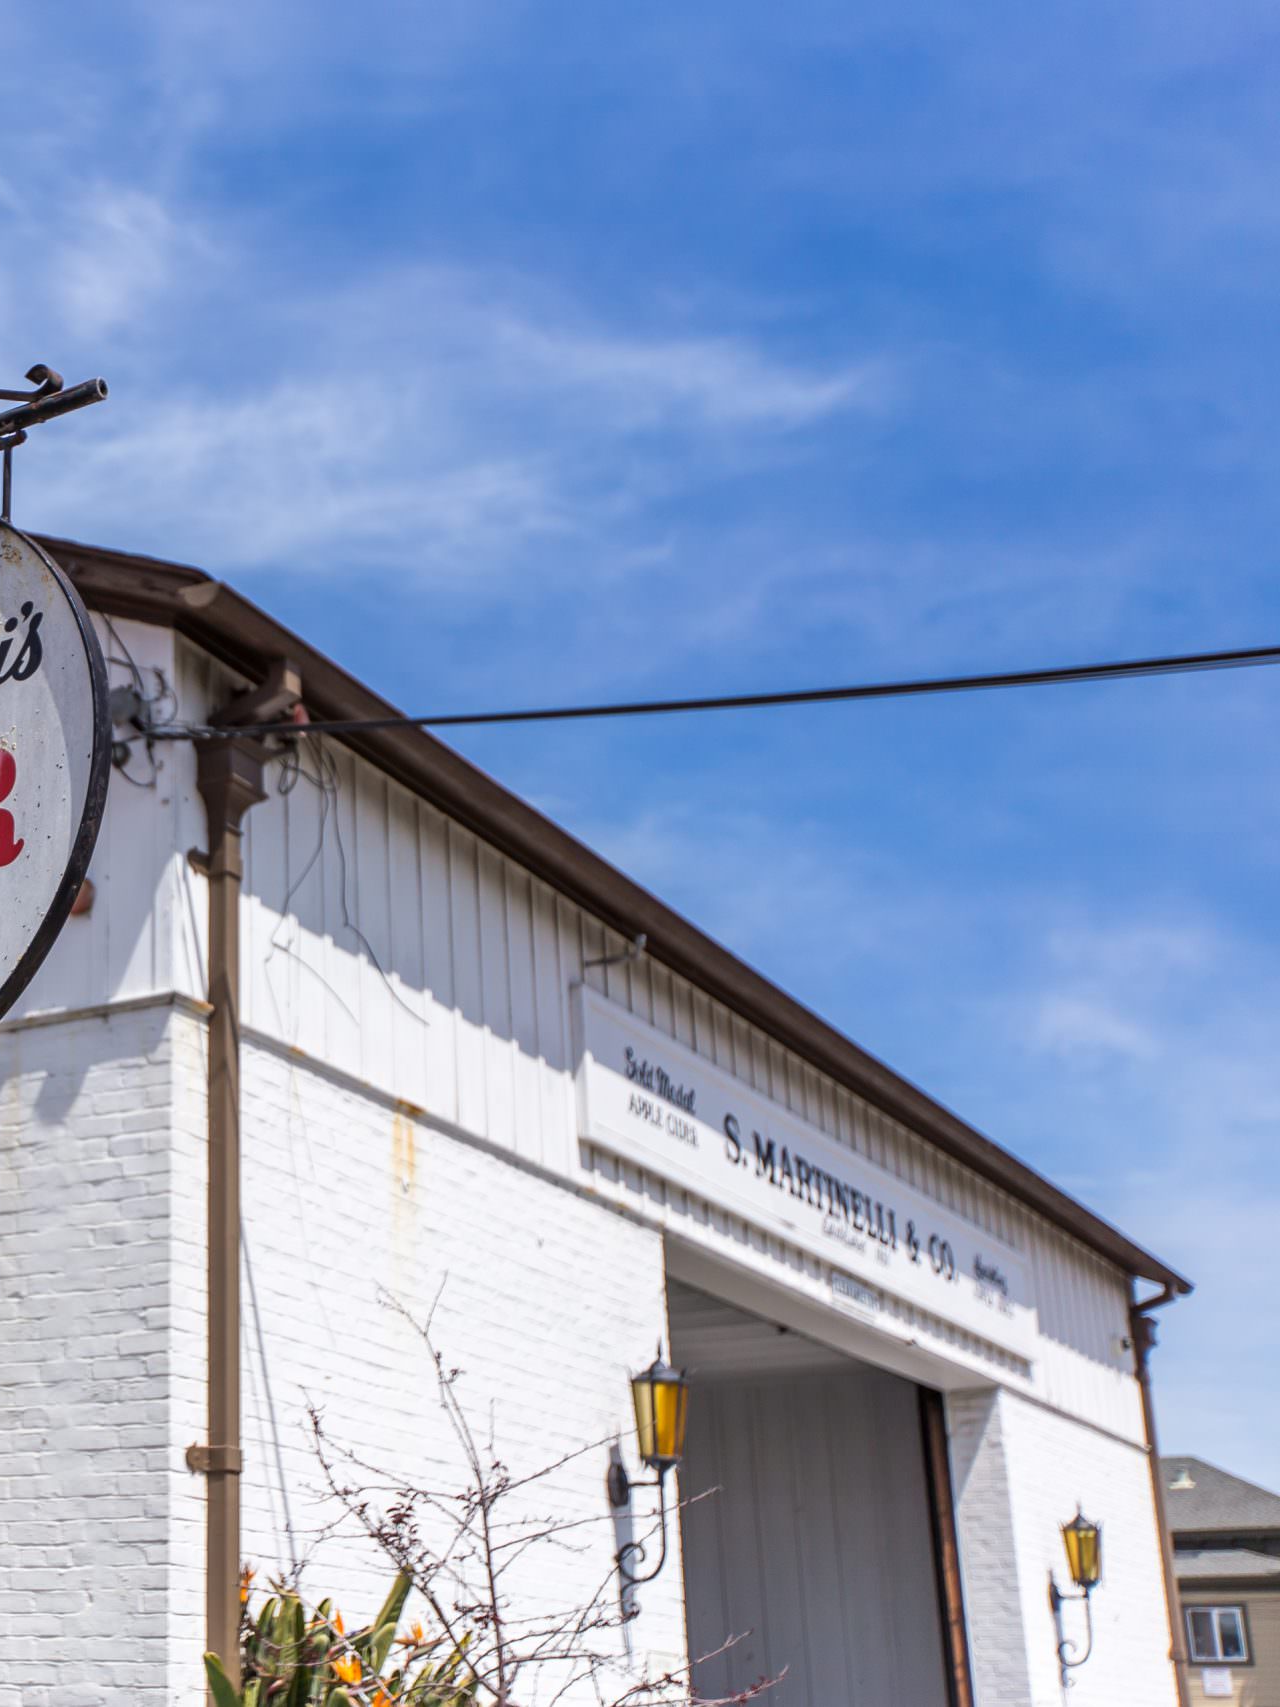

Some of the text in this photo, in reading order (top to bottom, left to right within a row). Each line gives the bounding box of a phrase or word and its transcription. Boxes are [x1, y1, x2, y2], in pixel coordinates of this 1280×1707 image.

[723, 1112, 747, 1167] S.
[753, 1130, 897, 1250] MARTINELLI
[905, 1219, 919, 1262] &
